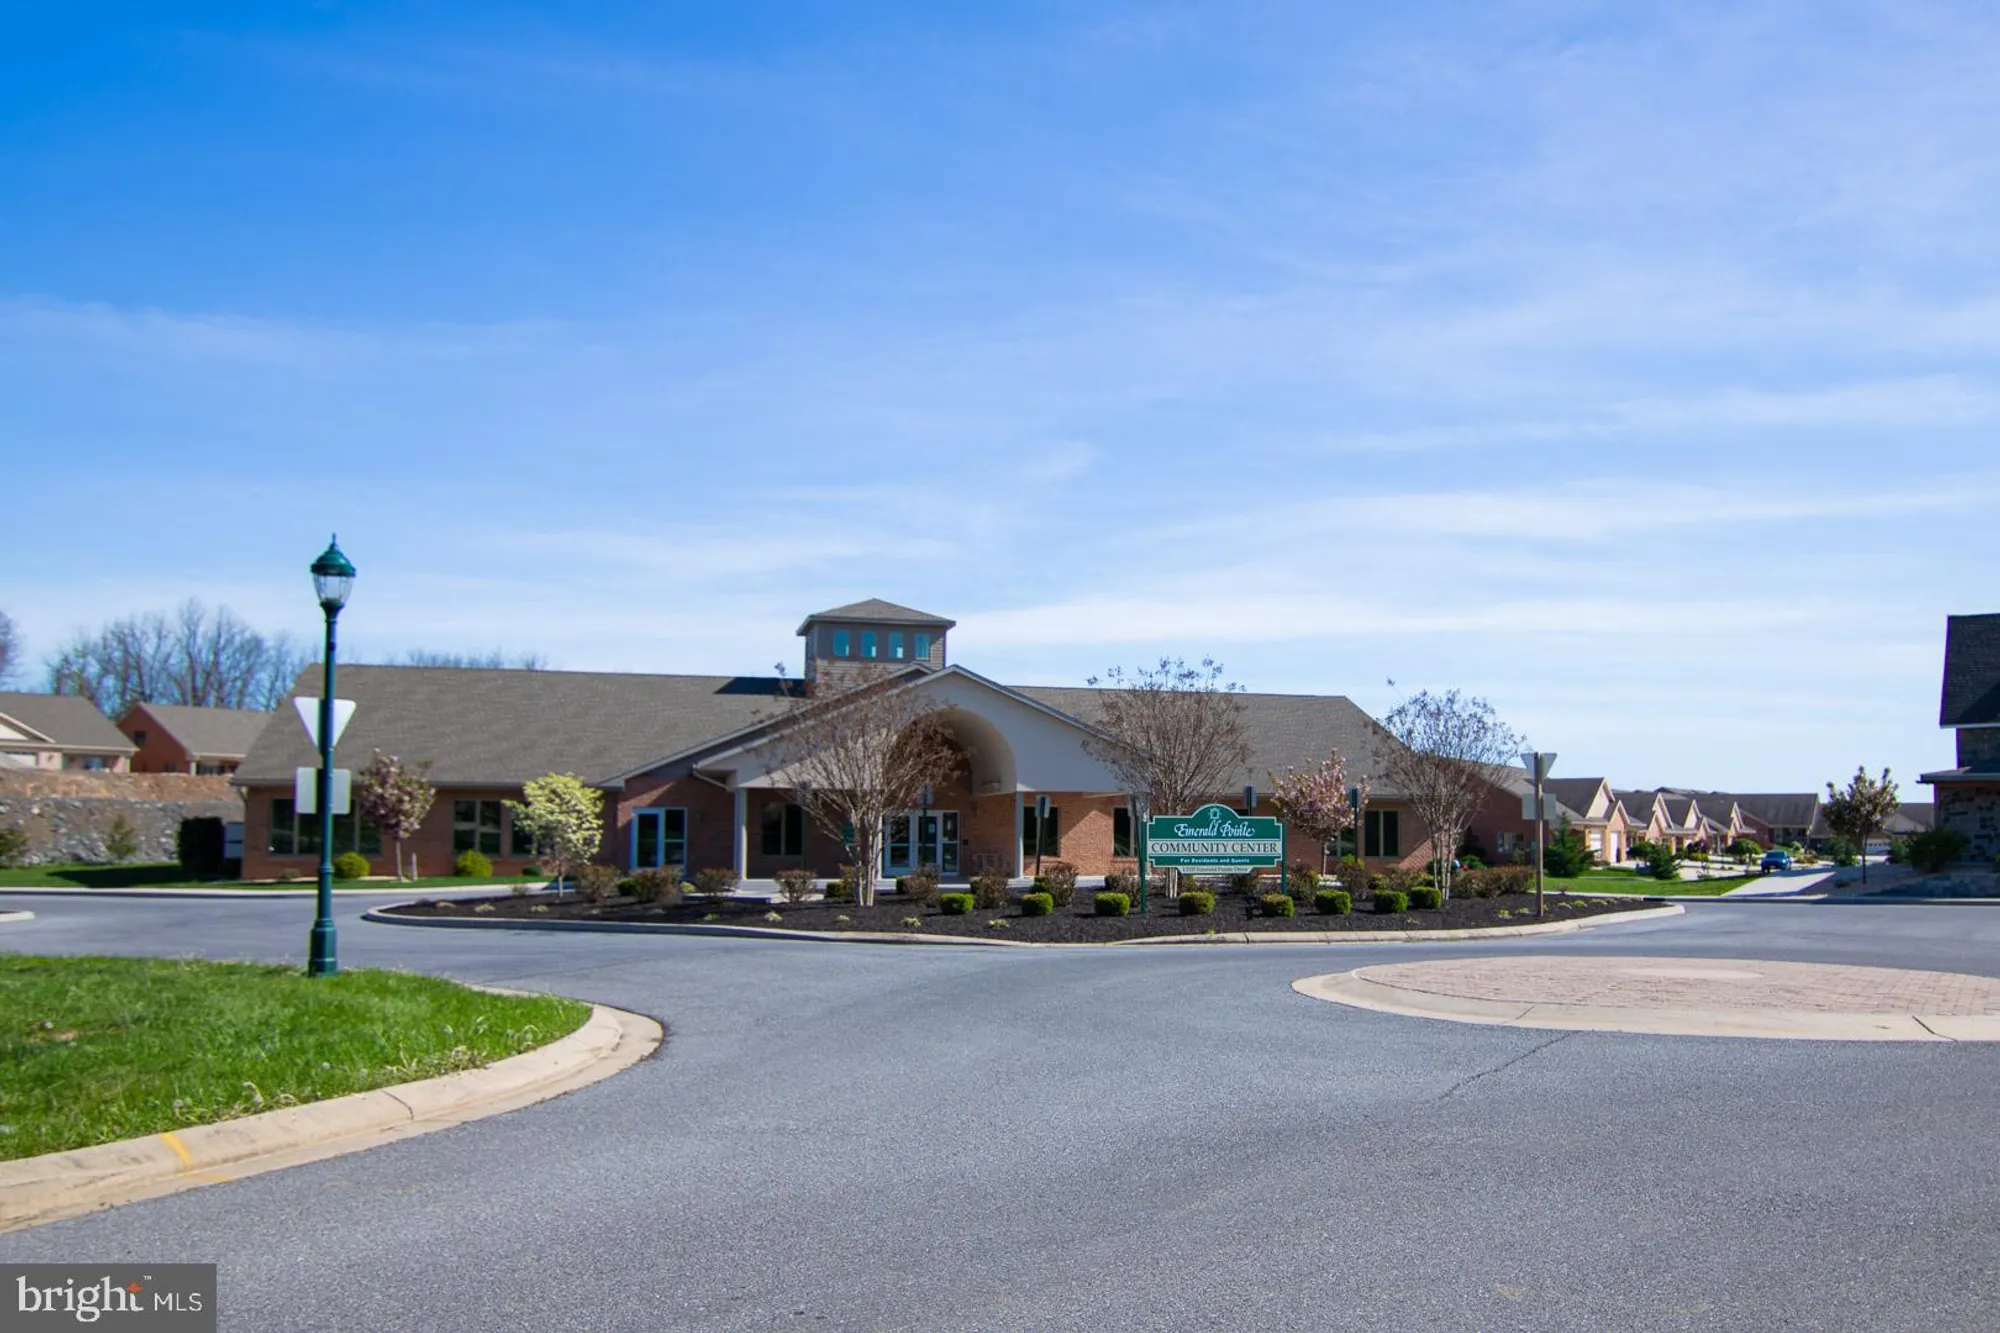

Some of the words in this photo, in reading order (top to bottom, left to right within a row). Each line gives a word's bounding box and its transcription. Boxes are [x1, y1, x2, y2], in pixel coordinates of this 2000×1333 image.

[1174, 819, 1221, 837] Emerald
[1151, 842, 1228, 853] COMMUNITY
[1231, 842, 1277, 853] CENTER
